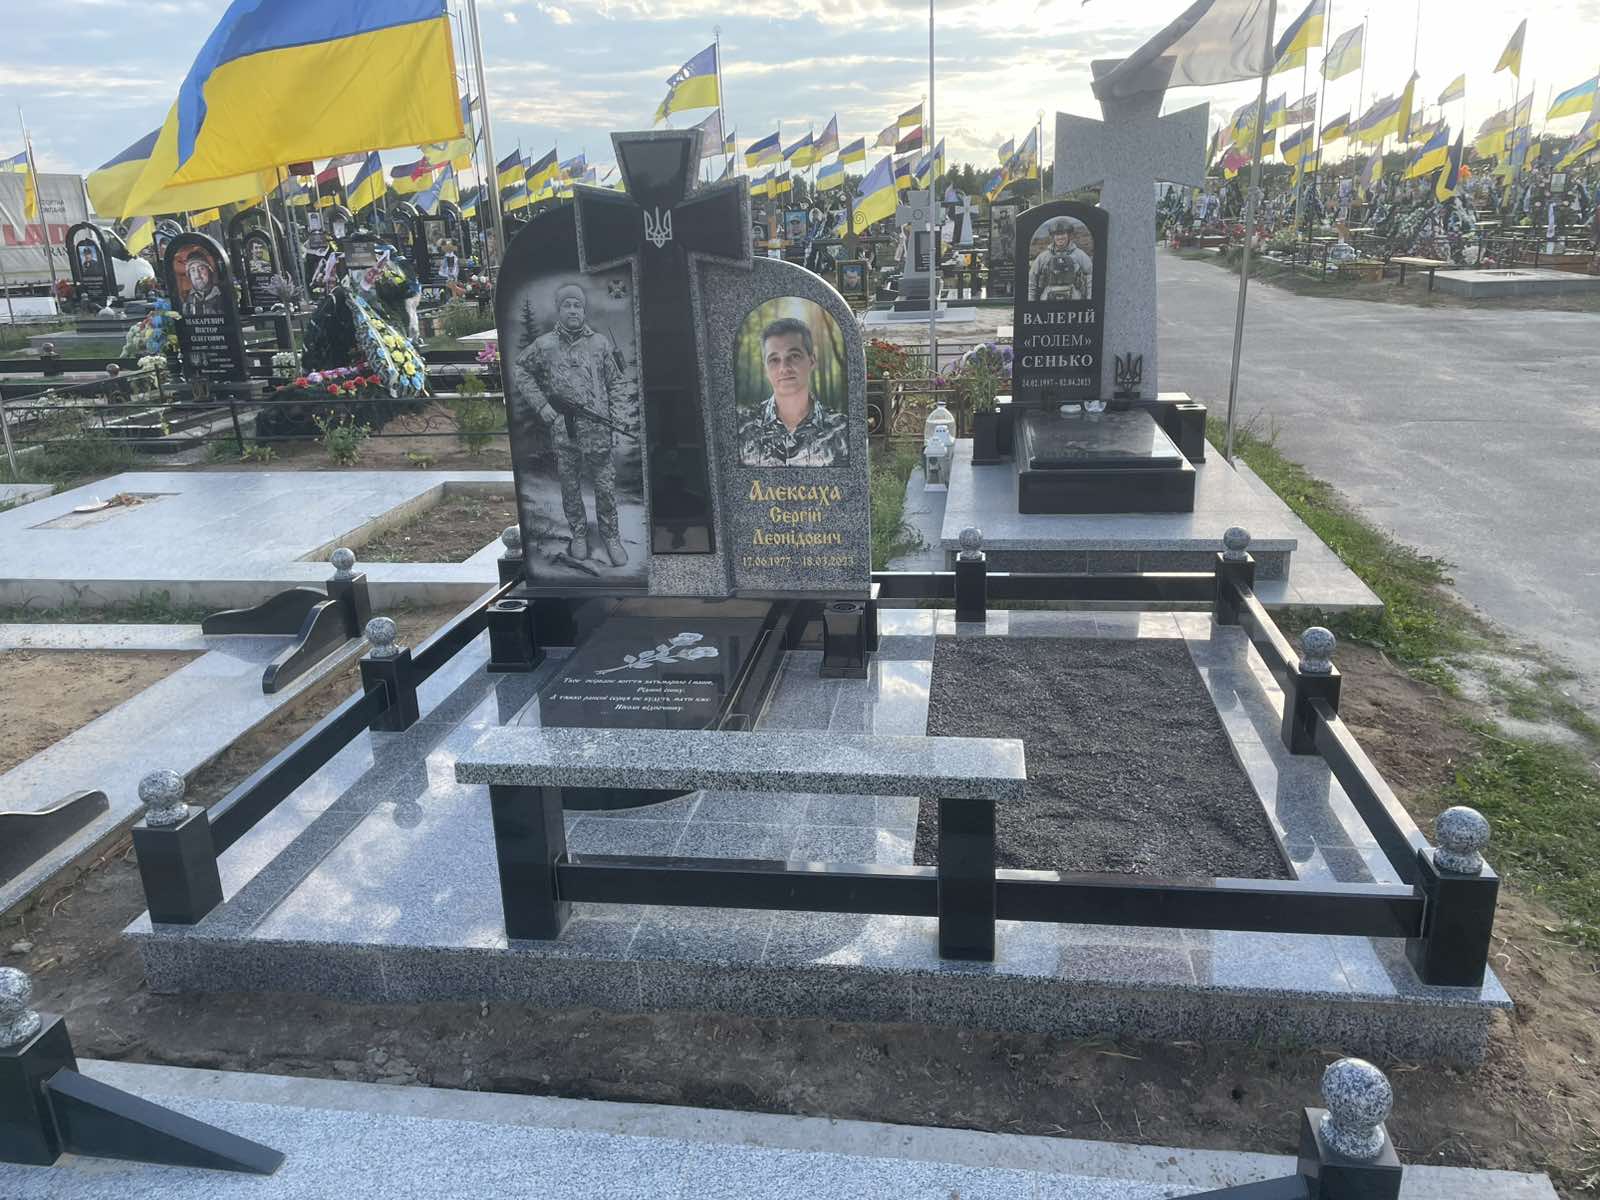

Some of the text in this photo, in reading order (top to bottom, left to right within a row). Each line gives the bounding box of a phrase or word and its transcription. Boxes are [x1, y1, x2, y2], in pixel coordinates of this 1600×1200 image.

[1023, 309, 1096, 325] ВАЛЕРІЙ
[1023, 334, 1092, 348] «ГОЛЕМ»
[1022, 354, 1094, 368] СЕНЬКО
[749, 479, 842, 506] Алексаха
[769, 506, 822, 526] Сергій
[752, 528, 842, 549] Леонідович
[743, 556, 791, 569] 17.06.1977
[802, 555, 855, 568] 18.03.2023
